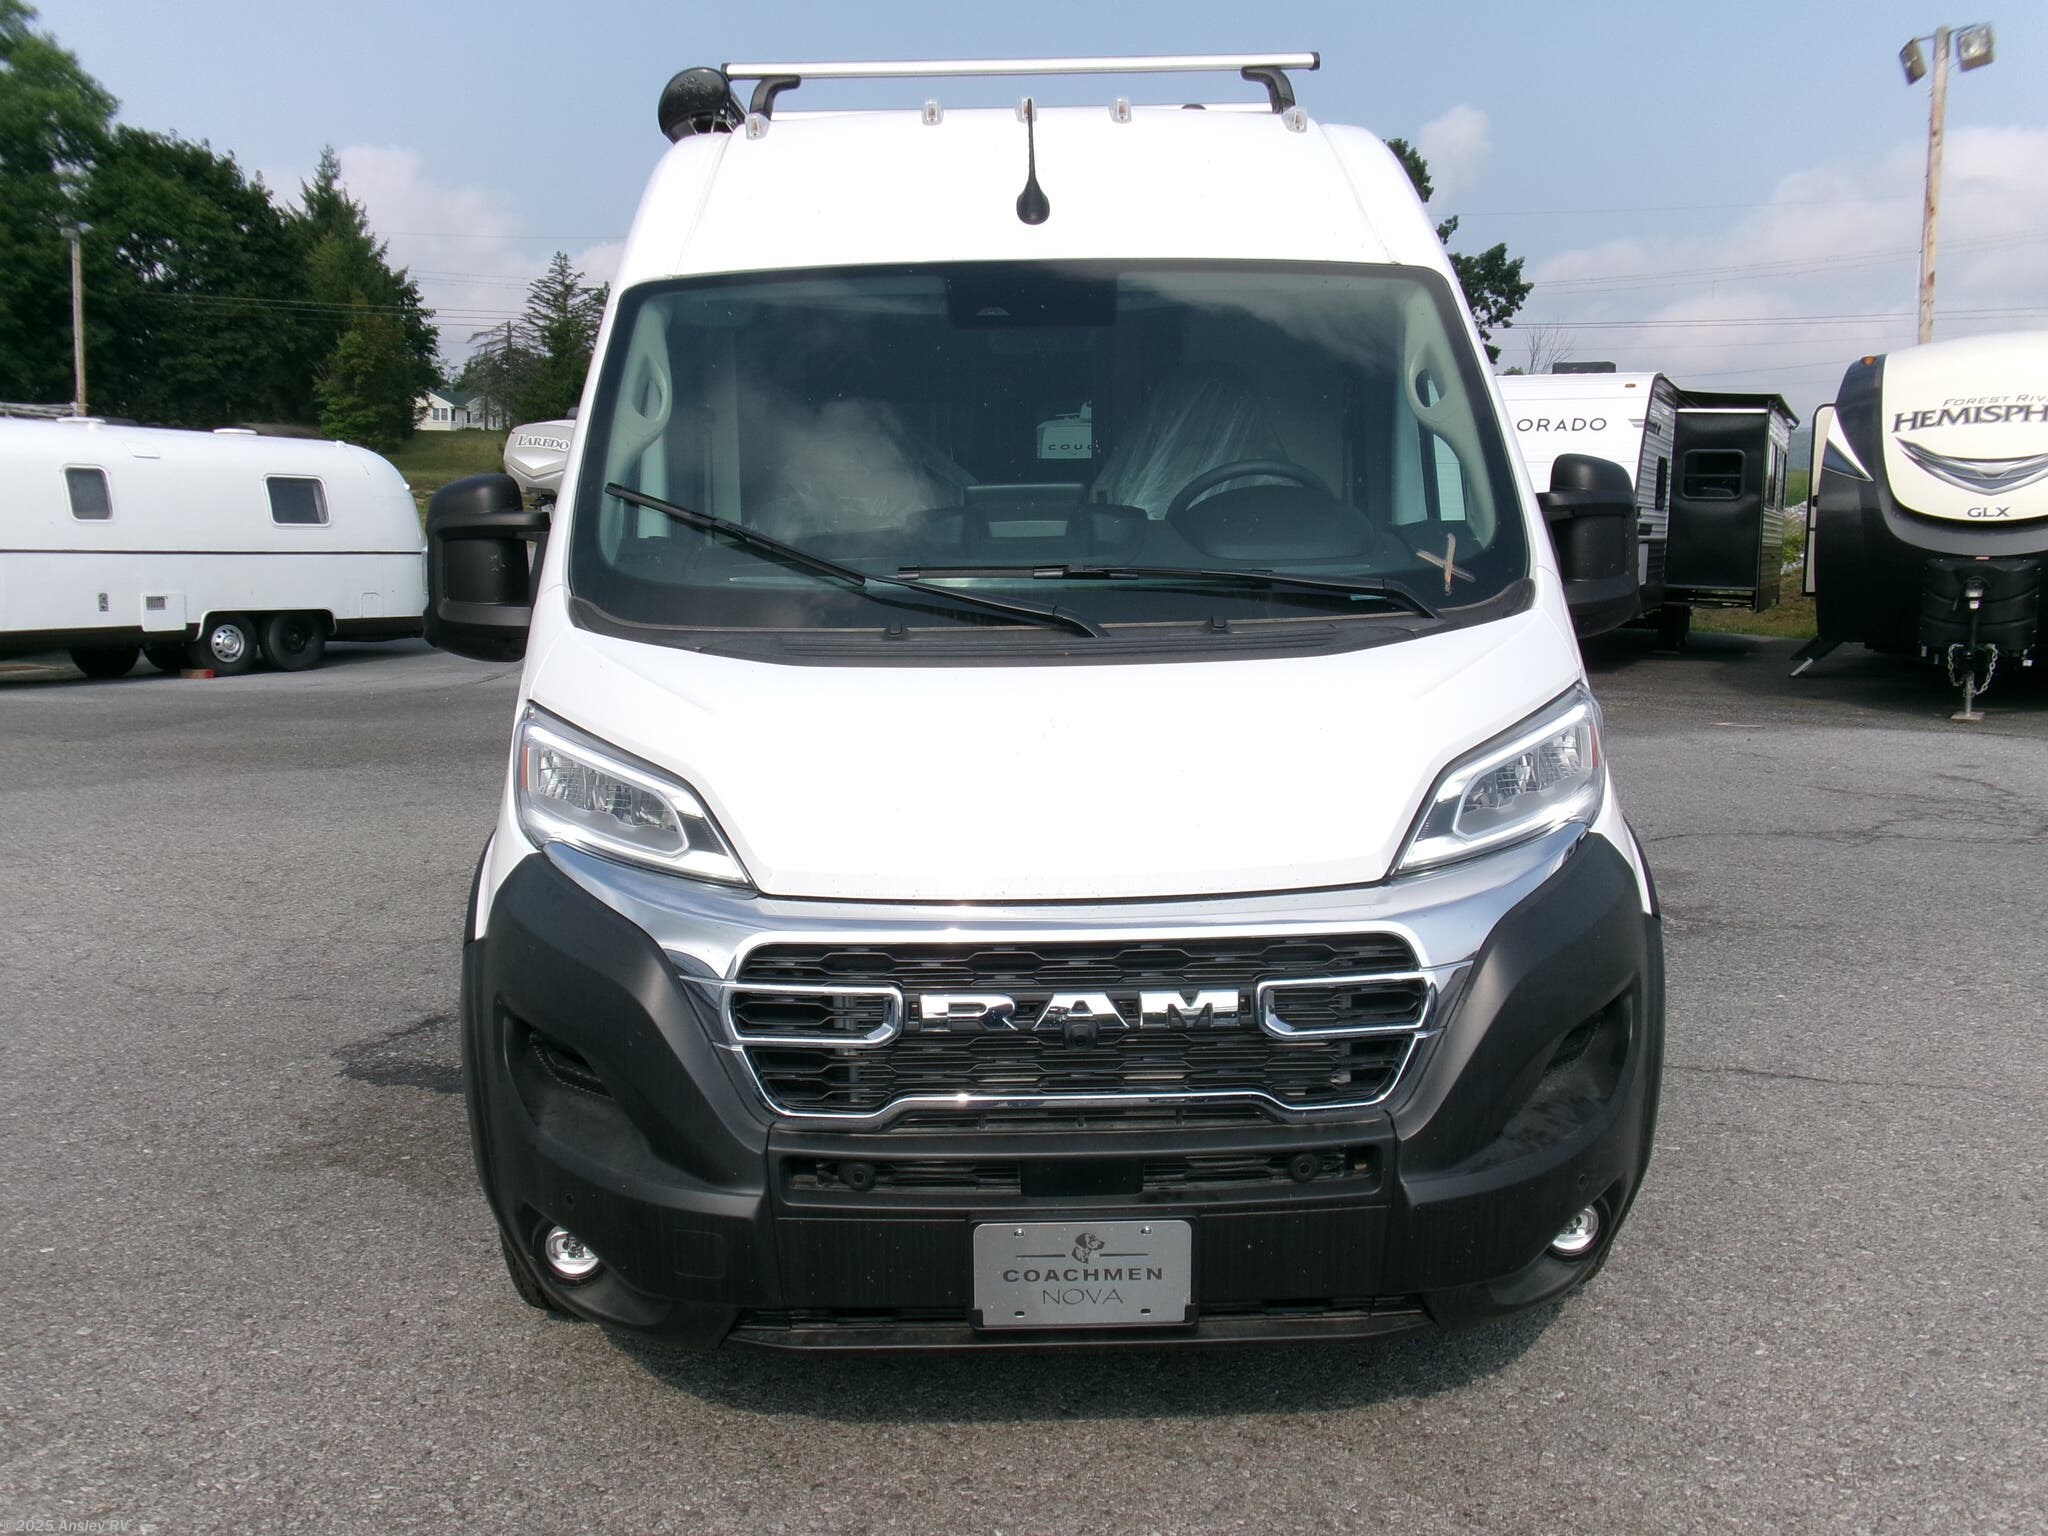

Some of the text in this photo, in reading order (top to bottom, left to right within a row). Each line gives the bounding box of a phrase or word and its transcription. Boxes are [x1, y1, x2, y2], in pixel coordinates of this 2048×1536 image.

[2016, 393, 2048, 403] RIV
[1516, 417, 1607, 432] ORADO
[1891, 403, 2048, 433] HEMISPH
[517, 434, 571, 451] LAREDO
[1967, 506, 2011, 518] GLX
[920, 988, 1240, 1032] RAM
[1002, 1267, 1163, 1283] COACHMEN
[1042, 1288, 1124, 1305] NOVA
